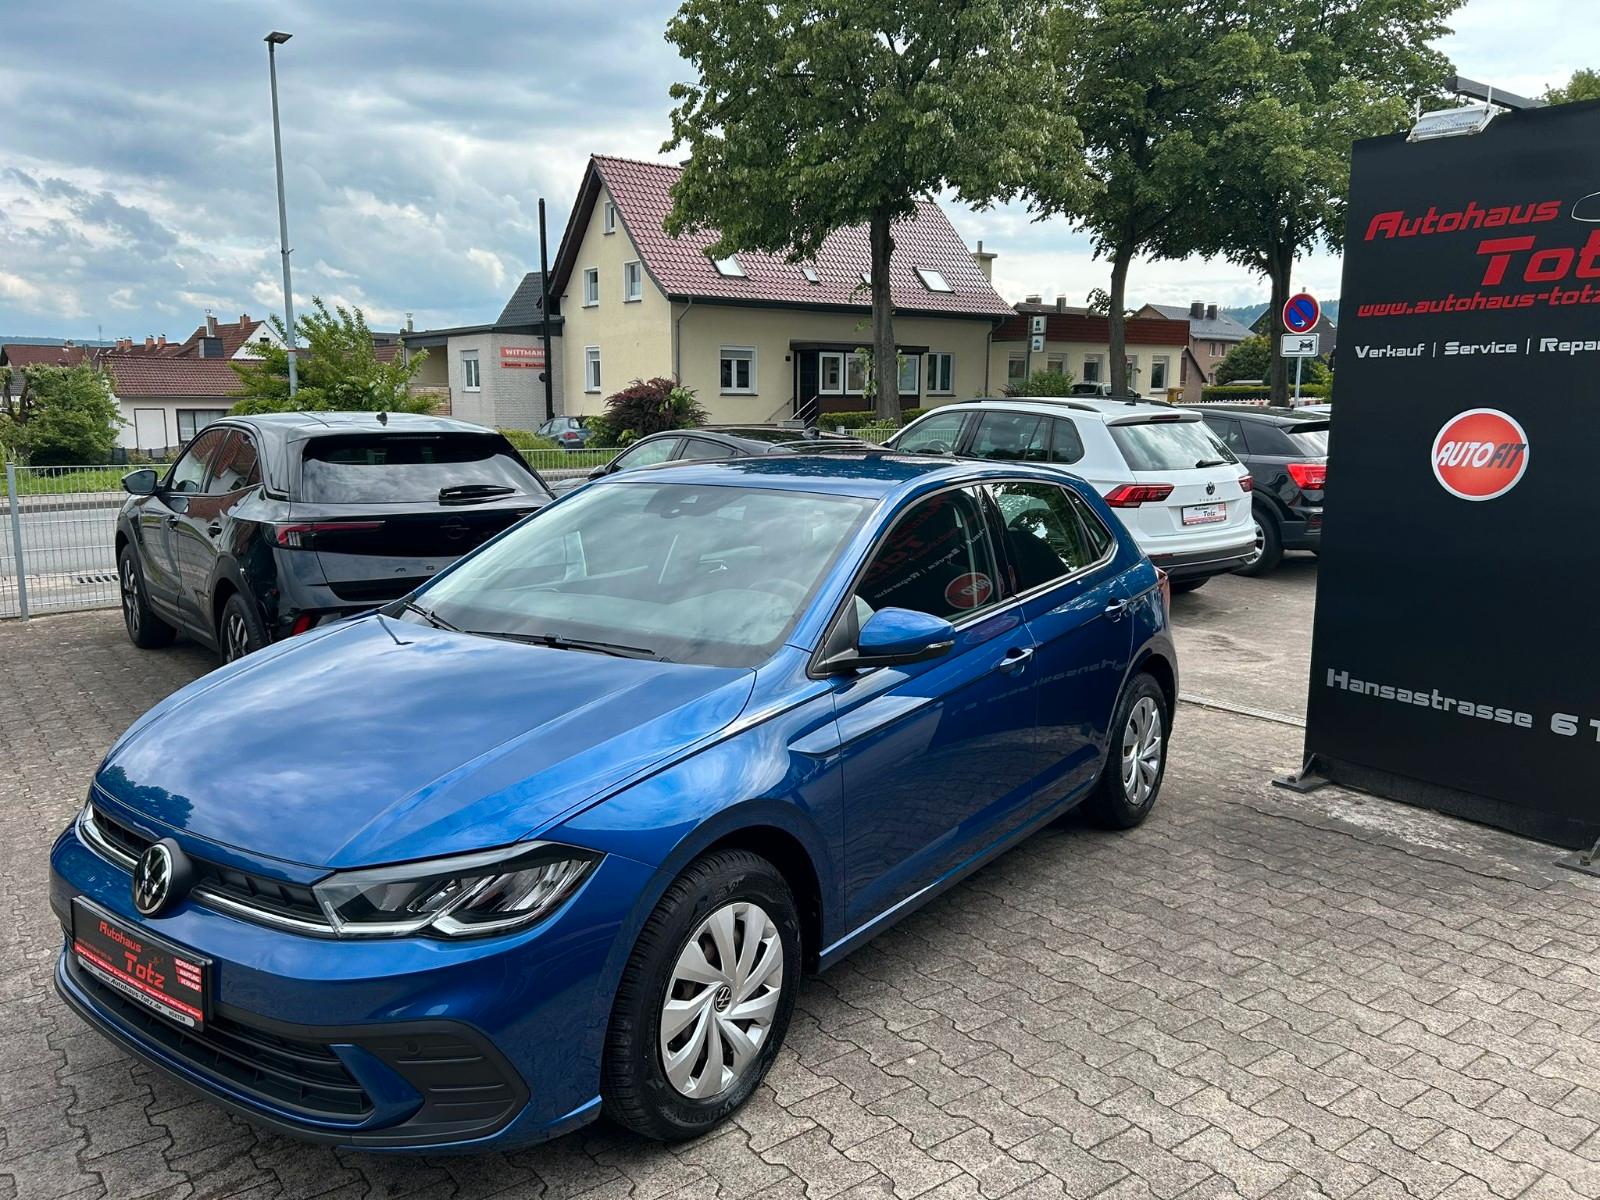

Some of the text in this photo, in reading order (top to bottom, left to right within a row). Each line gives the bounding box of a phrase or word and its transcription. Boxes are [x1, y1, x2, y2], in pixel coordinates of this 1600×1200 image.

[1364, 200, 1561, 240] Autohaus
[1355, 342, 1425, 358] Verkauf
[1444, 340, 1517, 355] Service
[1437, 441, 1527, 469] AUTOFIT
[1326, 667, 1533, 729] Hansastrasse
[1551, 712, 1579, 737] 6
[99, 920, 142, 953] Autohaus
[123, 950, 166, 989] Totz
